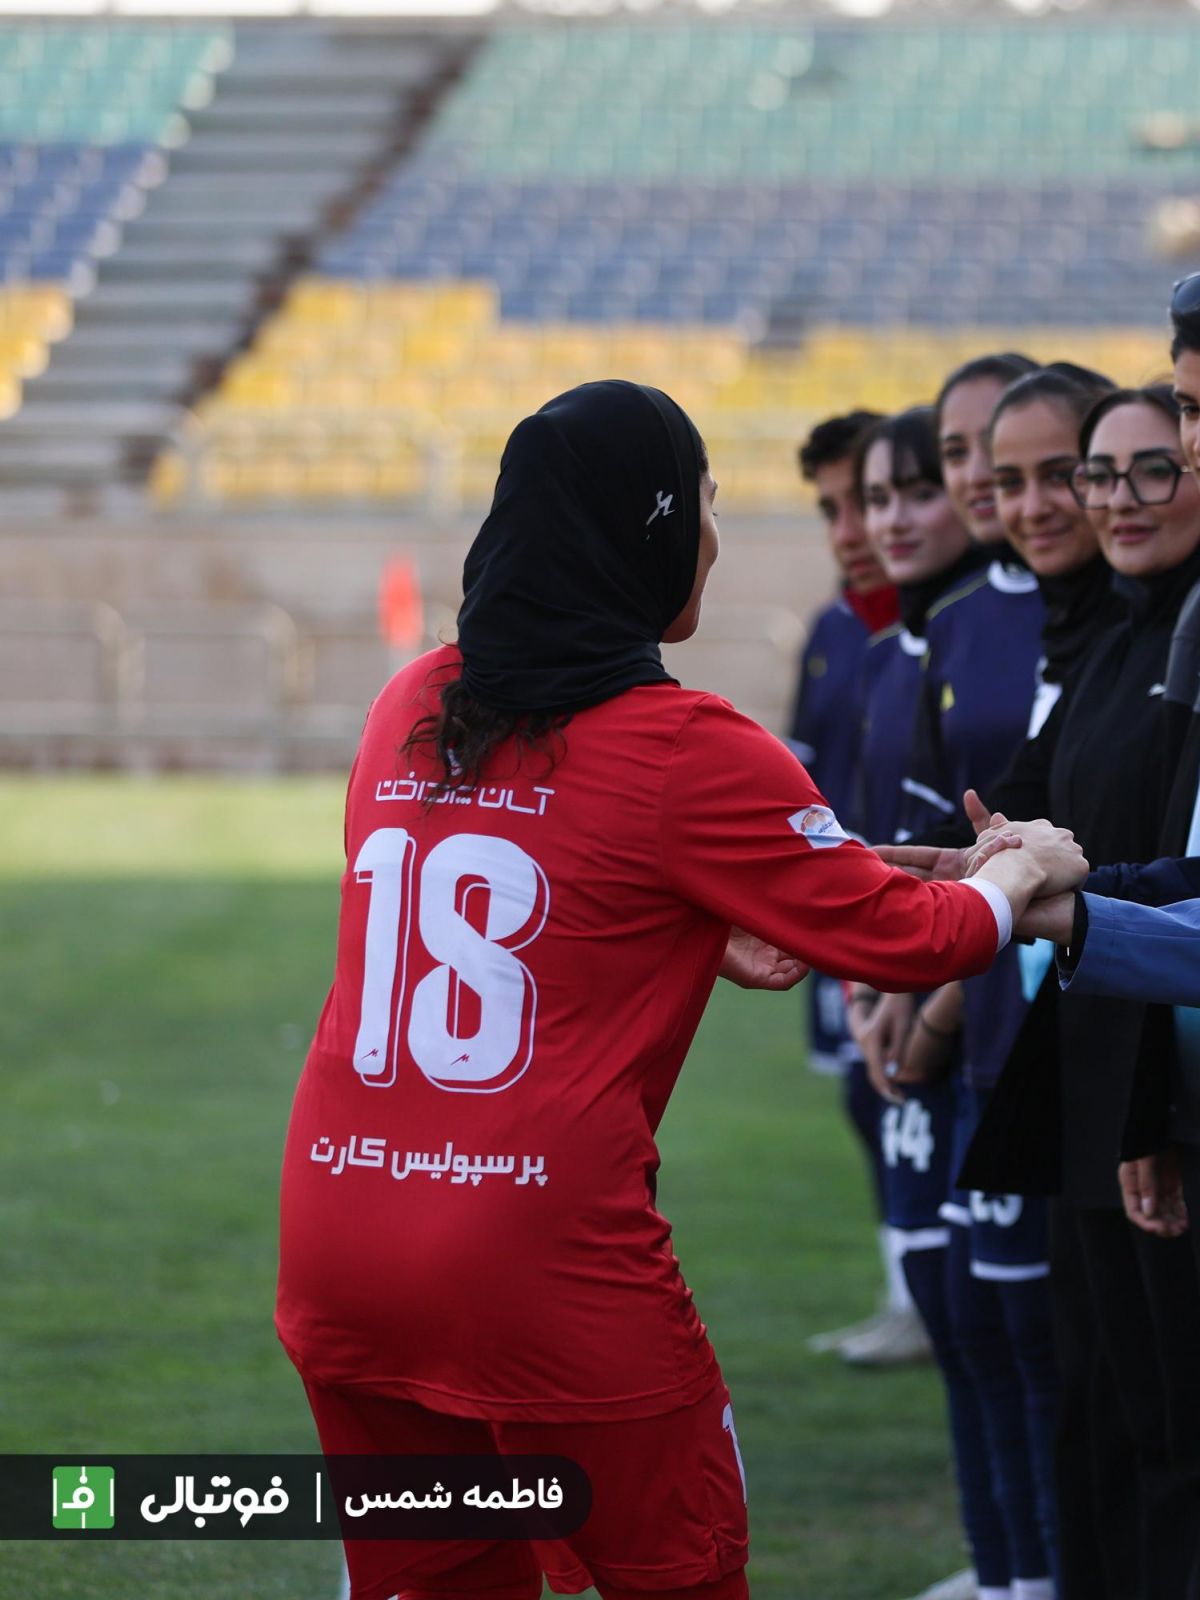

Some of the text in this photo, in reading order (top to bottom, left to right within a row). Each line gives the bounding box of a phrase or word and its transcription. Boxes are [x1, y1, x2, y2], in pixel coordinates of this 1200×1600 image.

[477, 786, 556, 816] آسان
[352, 827, 550, 1094] 18
[309, 1135, 549, 1187] پرسپولیس کارت
[882, 1099, 934, 1171] 14
